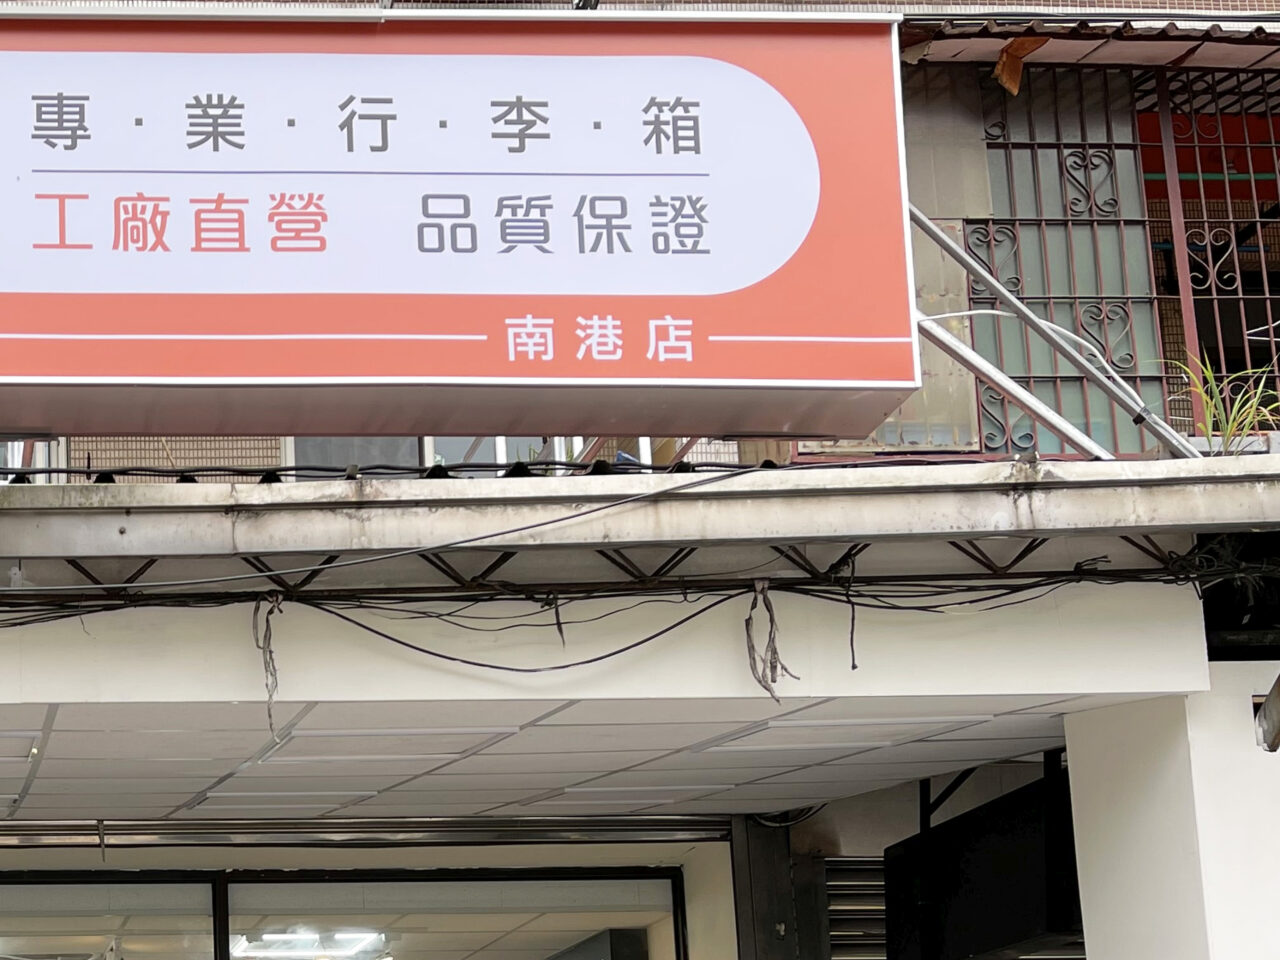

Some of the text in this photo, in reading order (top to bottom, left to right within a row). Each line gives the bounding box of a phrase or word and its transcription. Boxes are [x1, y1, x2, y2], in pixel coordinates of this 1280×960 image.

[32, 191, 712, 256] 工廠直營 品質保證
[504, 314, 695, 362] 南港店
